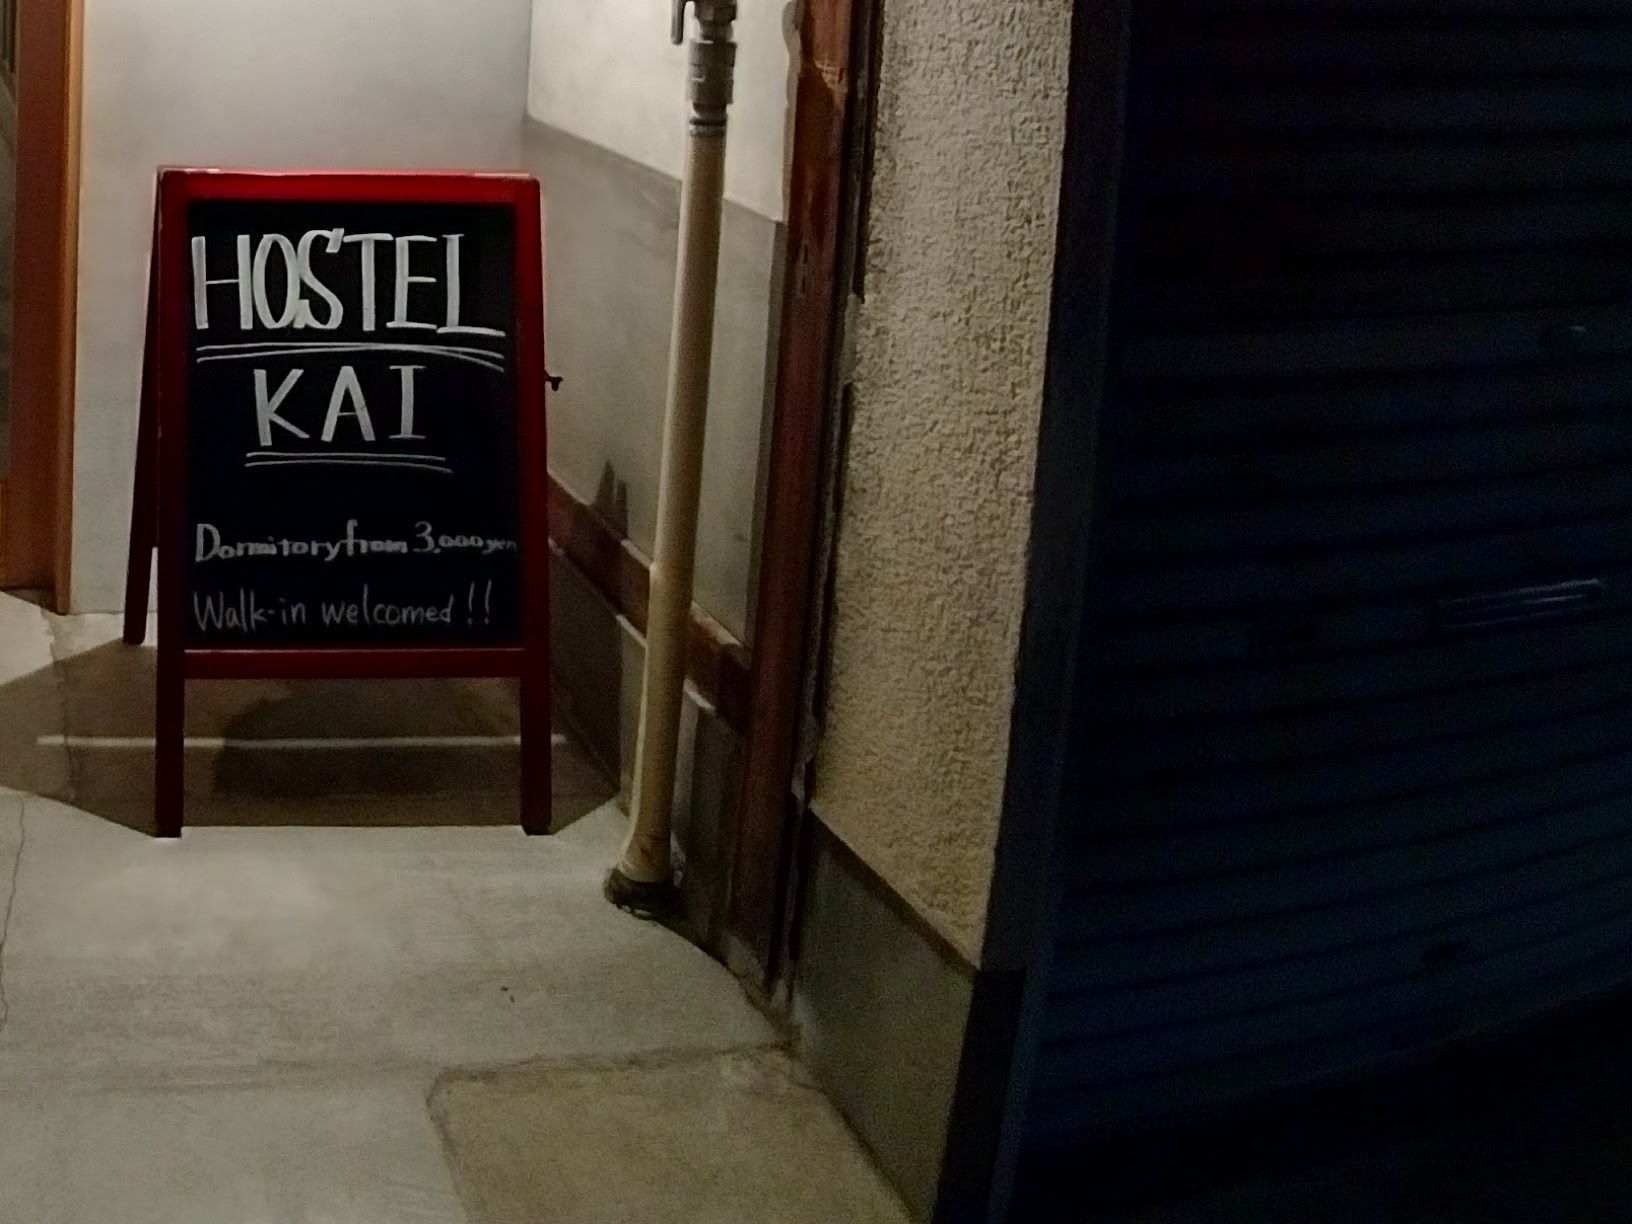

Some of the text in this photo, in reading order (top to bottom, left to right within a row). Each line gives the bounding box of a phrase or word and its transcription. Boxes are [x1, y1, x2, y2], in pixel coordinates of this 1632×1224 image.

[191, 228, 506, 337] HOSTEL
[253, 365, 428, 447] KAI
[193, 586, 307, 633] Walk-in
[322, 583, 455, 627] welcomed
